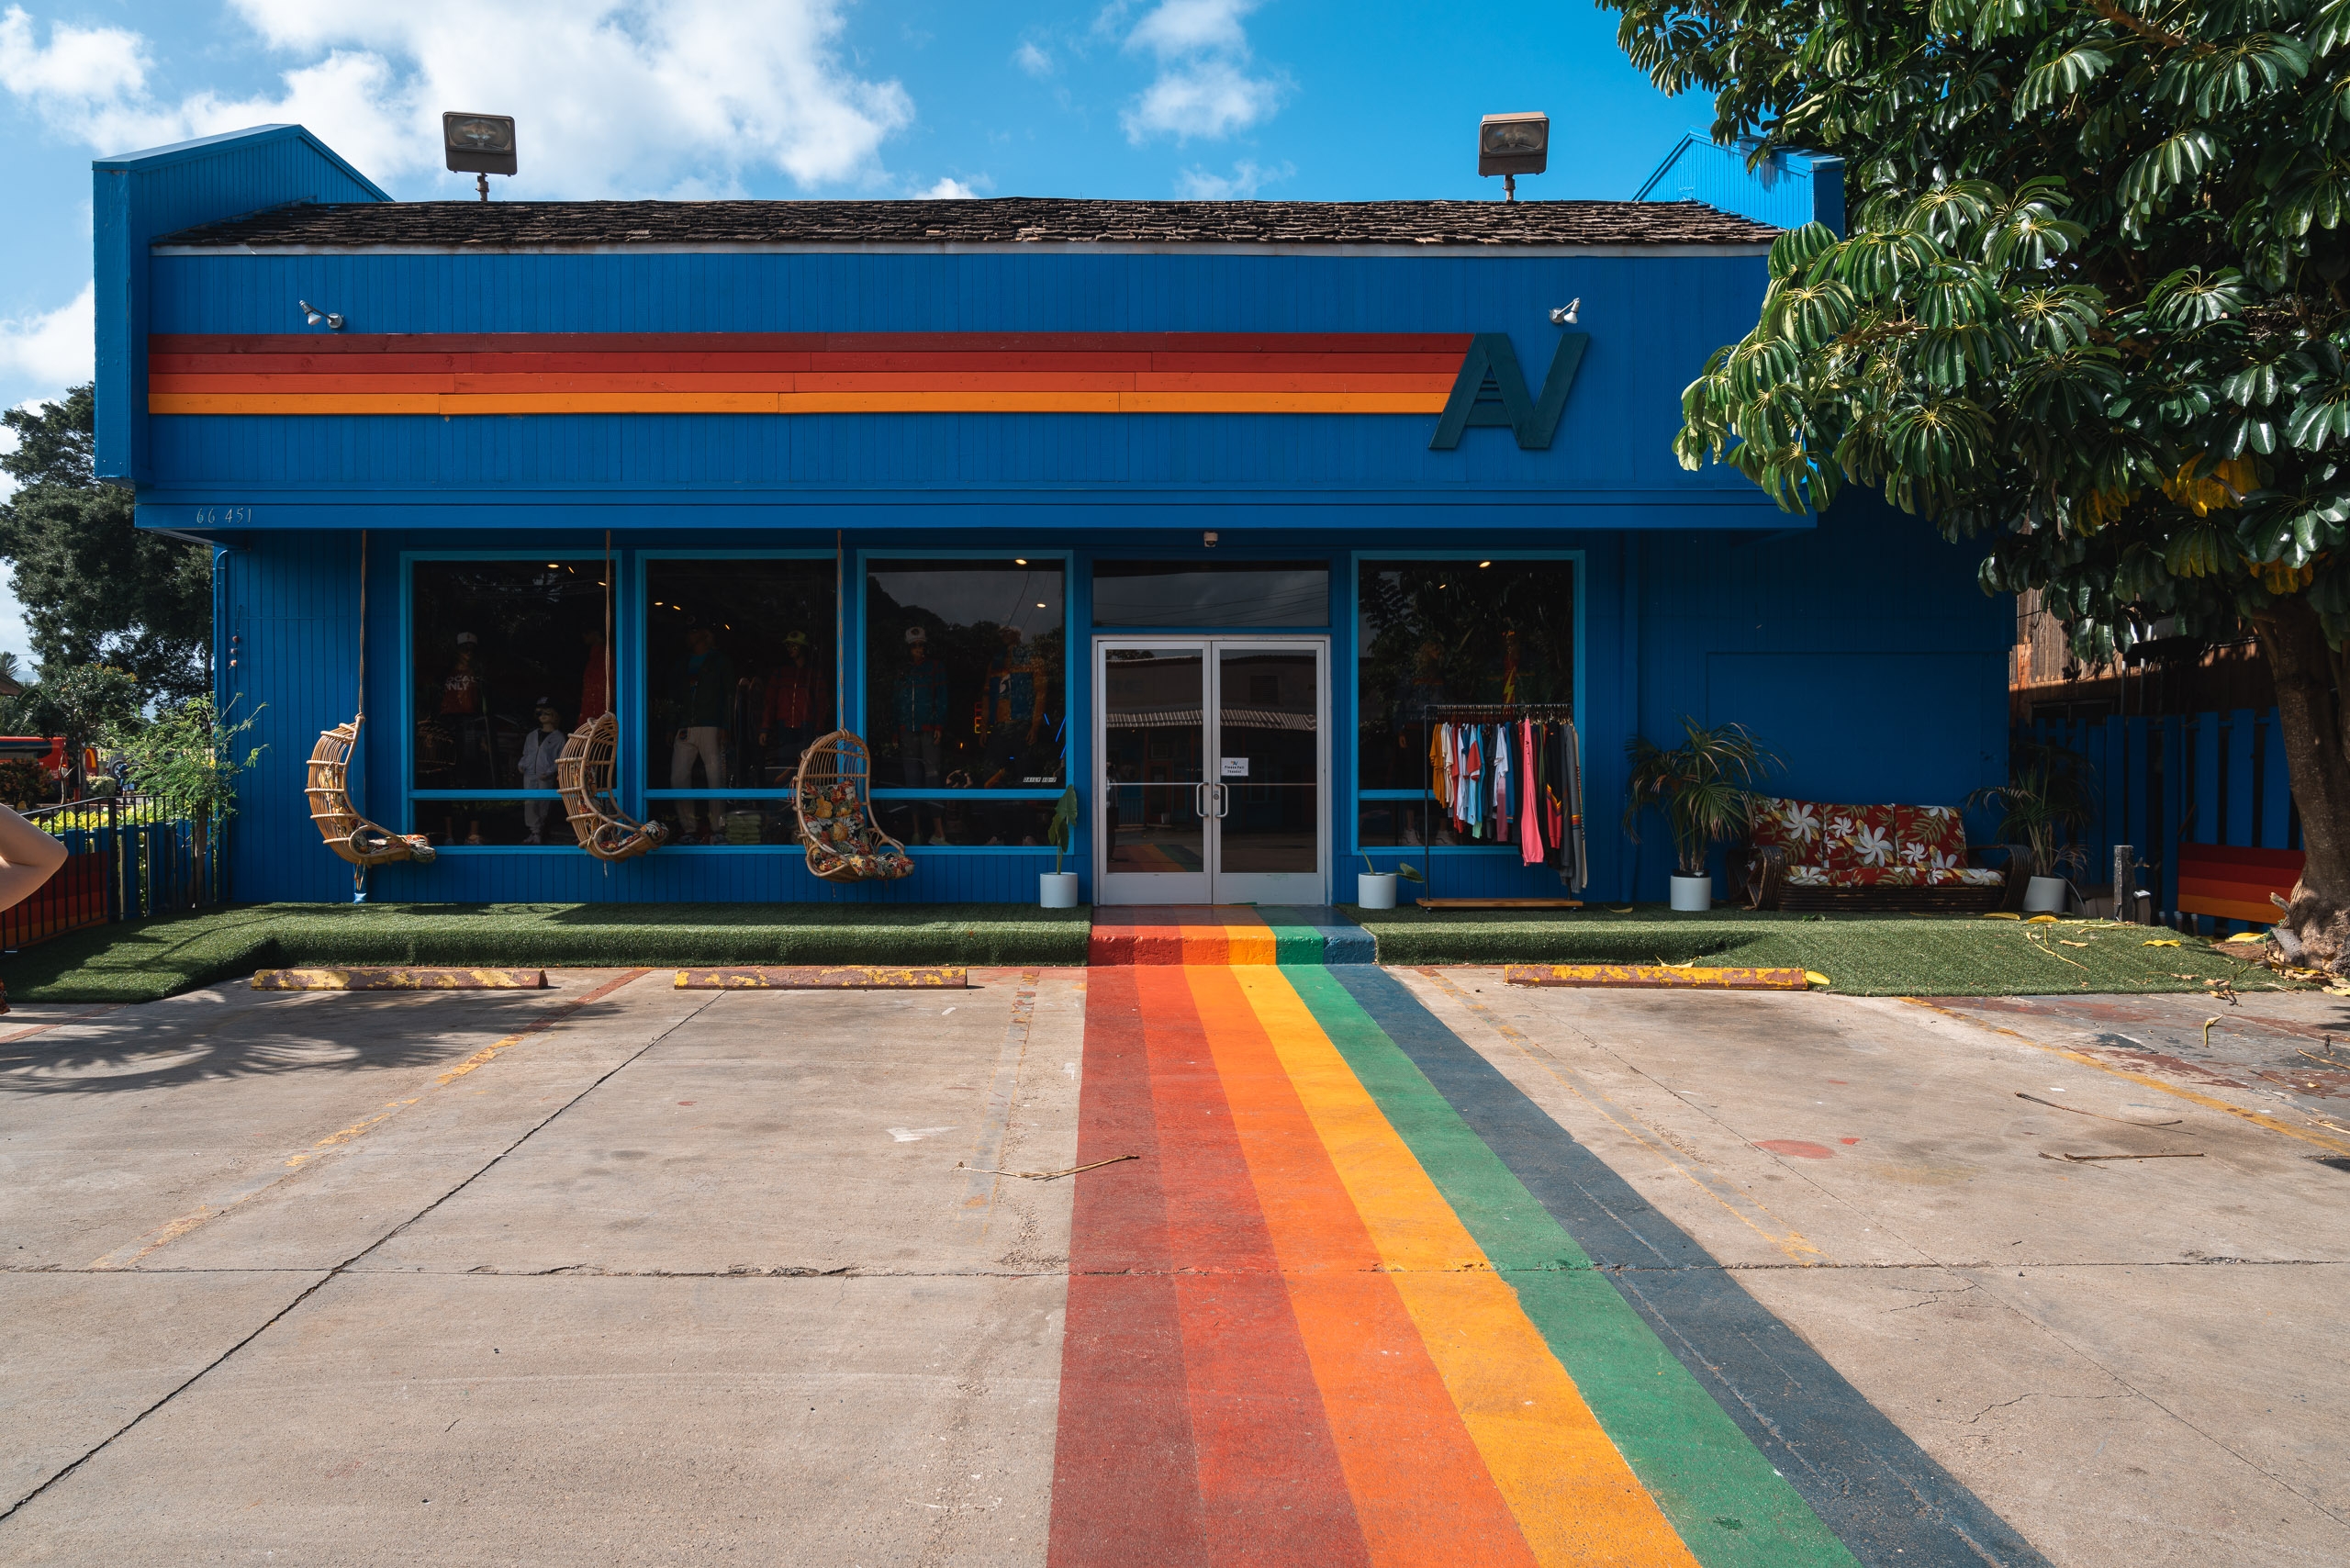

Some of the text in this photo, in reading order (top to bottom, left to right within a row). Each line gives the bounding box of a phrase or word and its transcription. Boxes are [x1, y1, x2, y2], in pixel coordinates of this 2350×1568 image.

[1428, 332, 1590, 450] AV
[196, 508, 252, 523] 66 451
